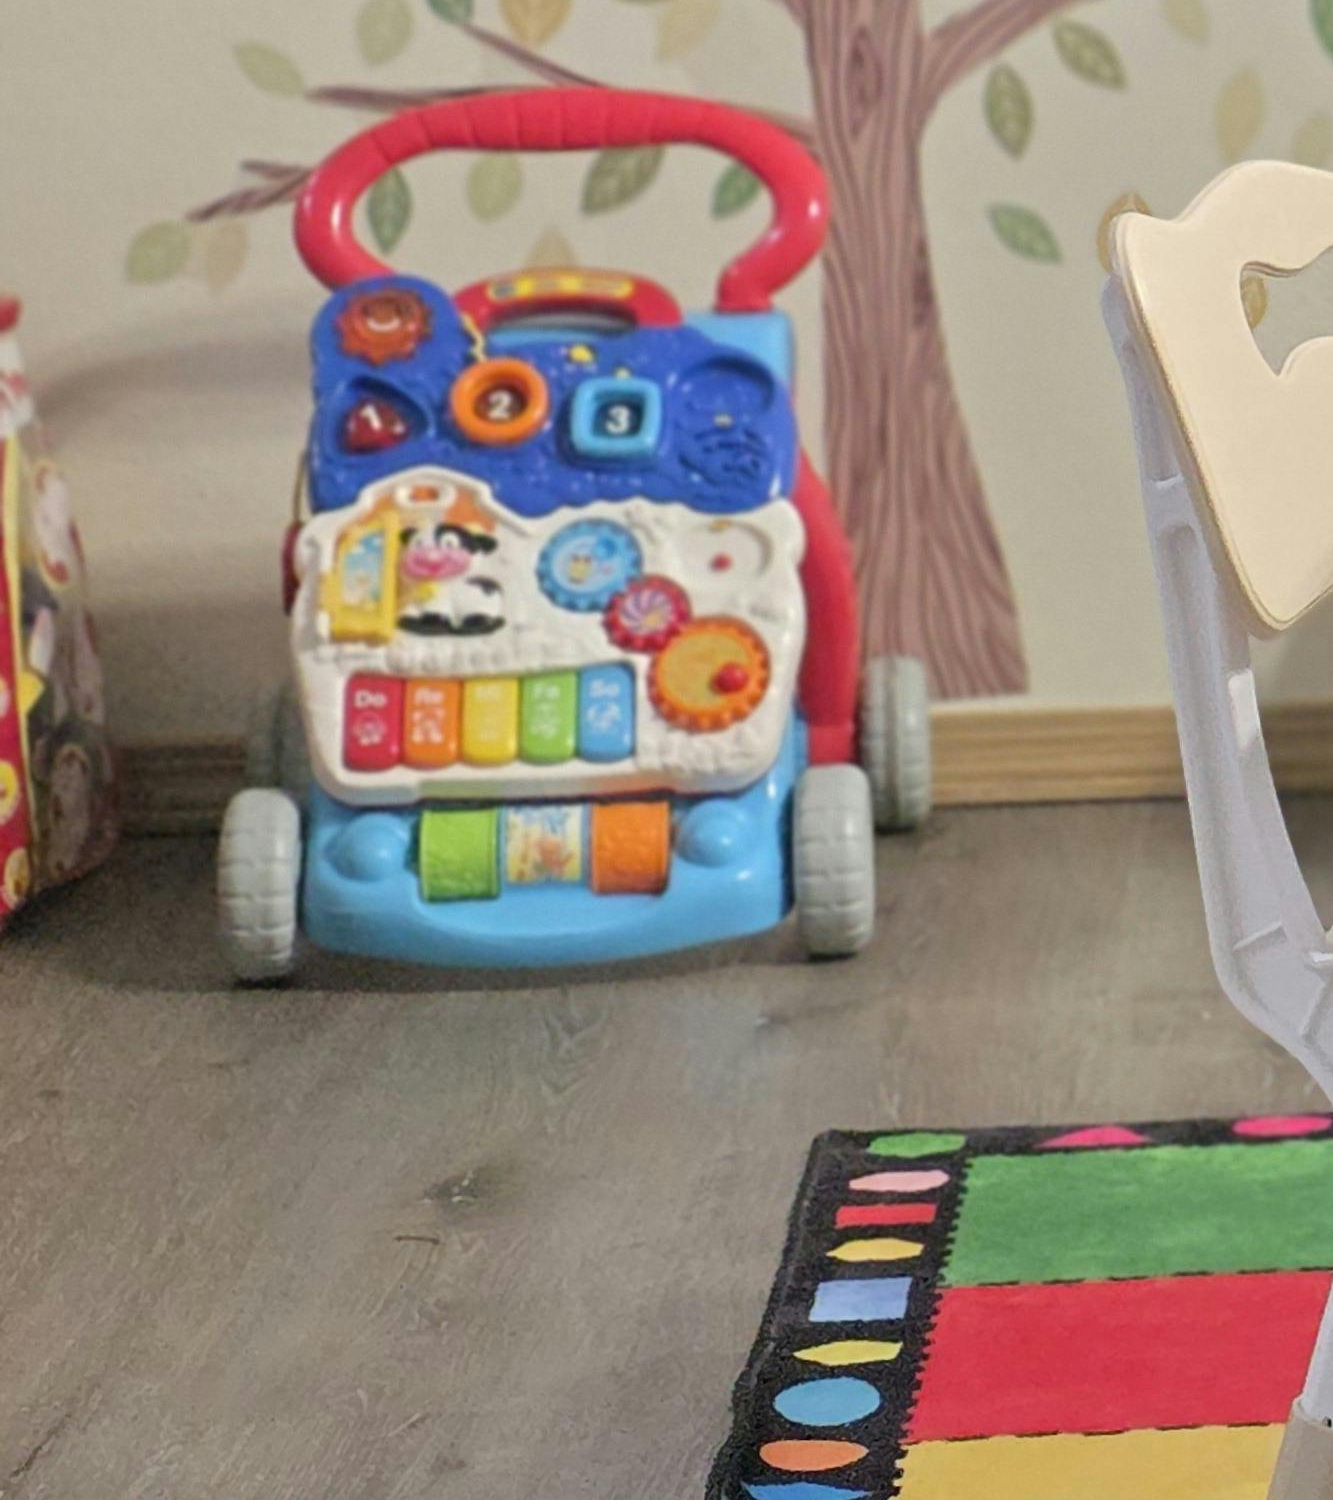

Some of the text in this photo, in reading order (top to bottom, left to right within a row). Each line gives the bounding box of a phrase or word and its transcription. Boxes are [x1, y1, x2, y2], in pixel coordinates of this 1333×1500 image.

[488, 390, 511, 419] 2
[360, 404, 383, 431] 1
[605, 405, 631, 433] 3
[414, 687, 445, 705] Re
[532, 682, 560, 699] Fa
[589, 679, 620, 698] So
[355, 690, 387, 709] Do
